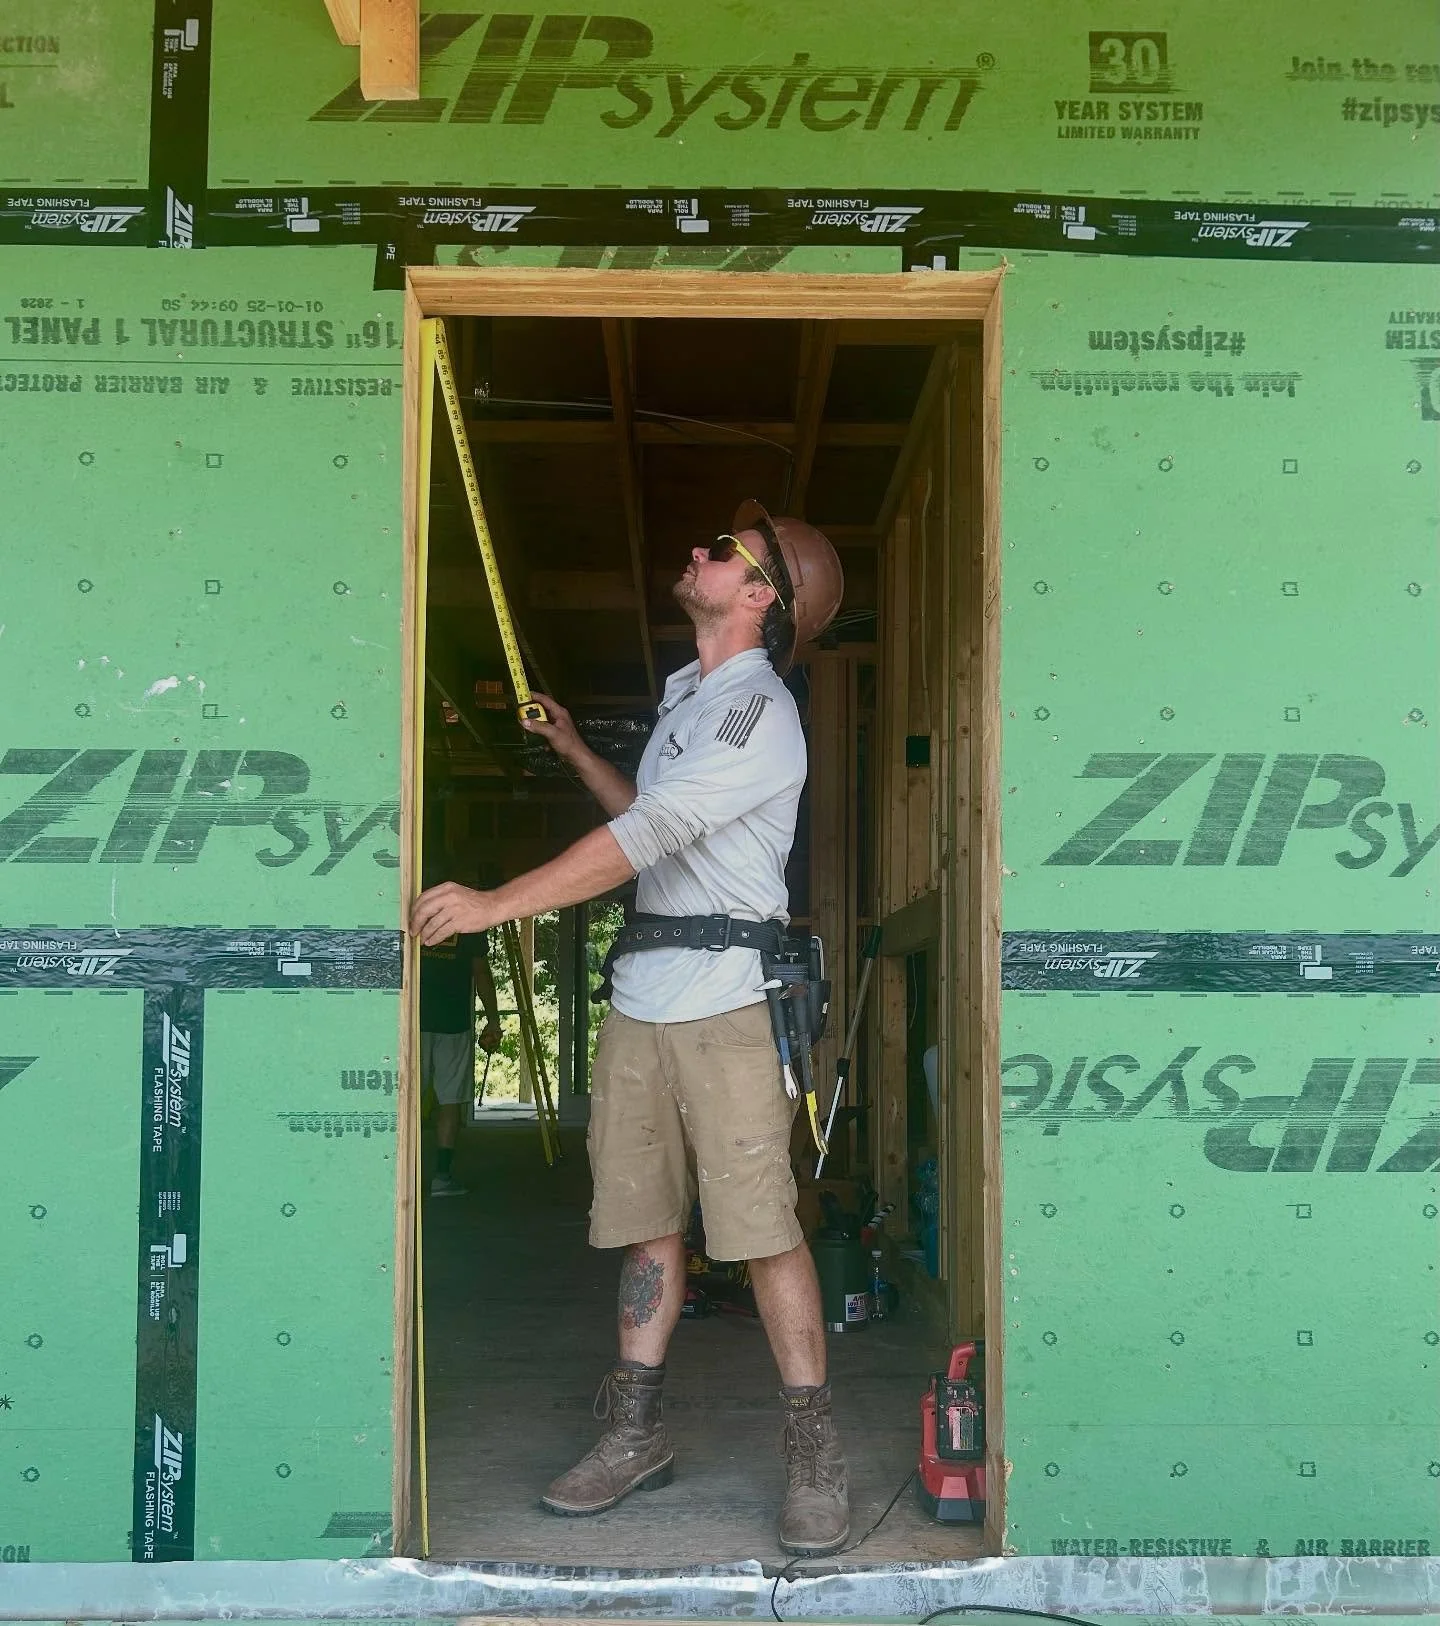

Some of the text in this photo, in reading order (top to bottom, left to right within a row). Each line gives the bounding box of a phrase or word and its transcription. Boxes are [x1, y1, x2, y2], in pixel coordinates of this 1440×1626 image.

[0, 36, 59, 53] CTION
[1098, 37, 1160, 86] 30
[1286, 56, 1342, 81] Join
[1352, 57, 1396, 82] the
[1054, 100, 1203, 121] YEAR SYSTEM
[1056, 125, 1200, 141] LIMITED WARRANTY
[7, 198, 90, 208] FLASHING TAPE
[398, 197, 482, 207] FLASHING TAPE
[787, 199, 869, 208] FLASHING TAPE
[1174, 211, 1256, 222] FLASHING TAPE
[76, 299, 85, 309] 1
[190, 299, 238, 312] 09:44
[247, 300, 323, 313] 01-01-25
[1388, 311, 1440, 325] RANTY
[3, 317, 101, 346] PANEL
[115, 318, 130, 346] 1
[141, 317, 334, 348] STRUCTURAL
[1088, 325, 1246, 358] #zipsystem
[0, 373, 82, 393] PROTEC
[94, 375, 183, 395] BARRIER
[195, 376, 231, 395] AIR
[253, 377, 268, 396] &
[1040, 371, 1299, 399] Join the revolution
[23, 940, 77, 951] FLASHING
[1020, 942, 1104, 953] FLASHING TAPE
[1411, 945, 1439, 955] TAPE
[341, 1069, 398, 1096] tem
[153, 1067, 164, 1153] FLASHING TAPE
[144, 1472, 156, 1559] FLASHING TAPE
[0, 1545, 30, 1563] ON
[1051, 1538, 1431, 1557] WATER-RESISTIVE & AIR BARRIER
